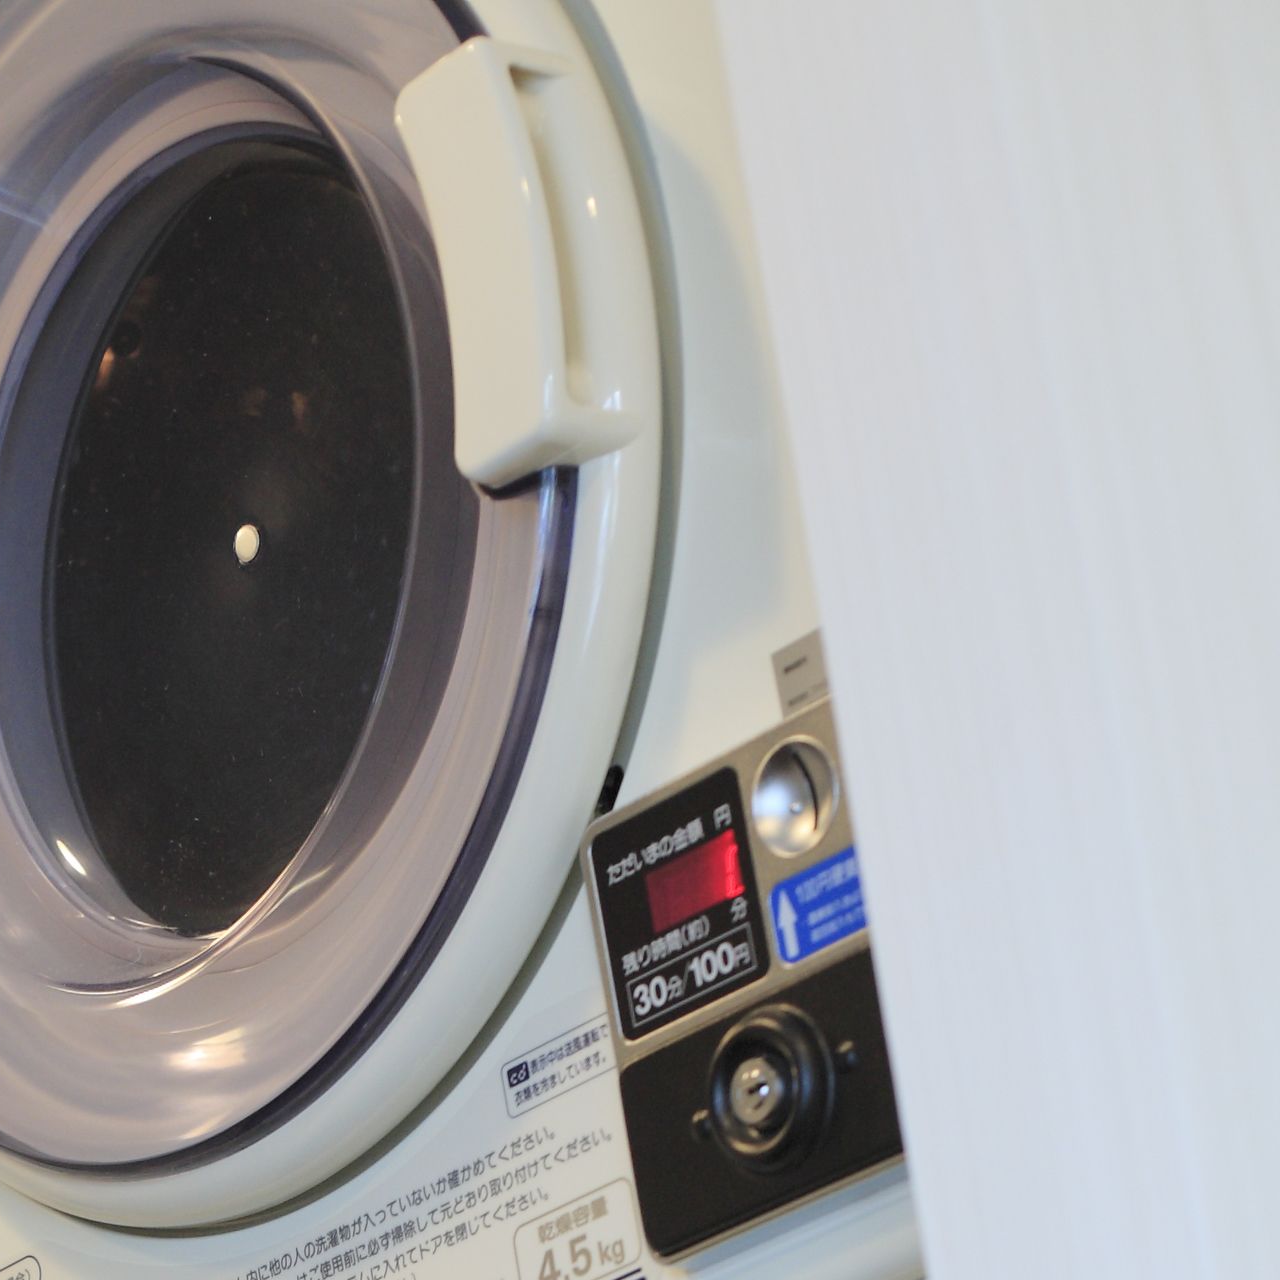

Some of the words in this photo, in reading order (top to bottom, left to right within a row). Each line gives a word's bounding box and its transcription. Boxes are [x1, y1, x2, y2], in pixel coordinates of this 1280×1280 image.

[606, 818, 703, 886] ただいまの金額
[714, 803, 732, 830] 円
[732, 897, 748, 923] 分
[621, 914, 711, 976] 残り時間(約)
[633, 948, 752, 1017] 30分/100円
[538, 1195, 608, 1245] 乾燥容量
[597, 1232, 626, 1267] kg
